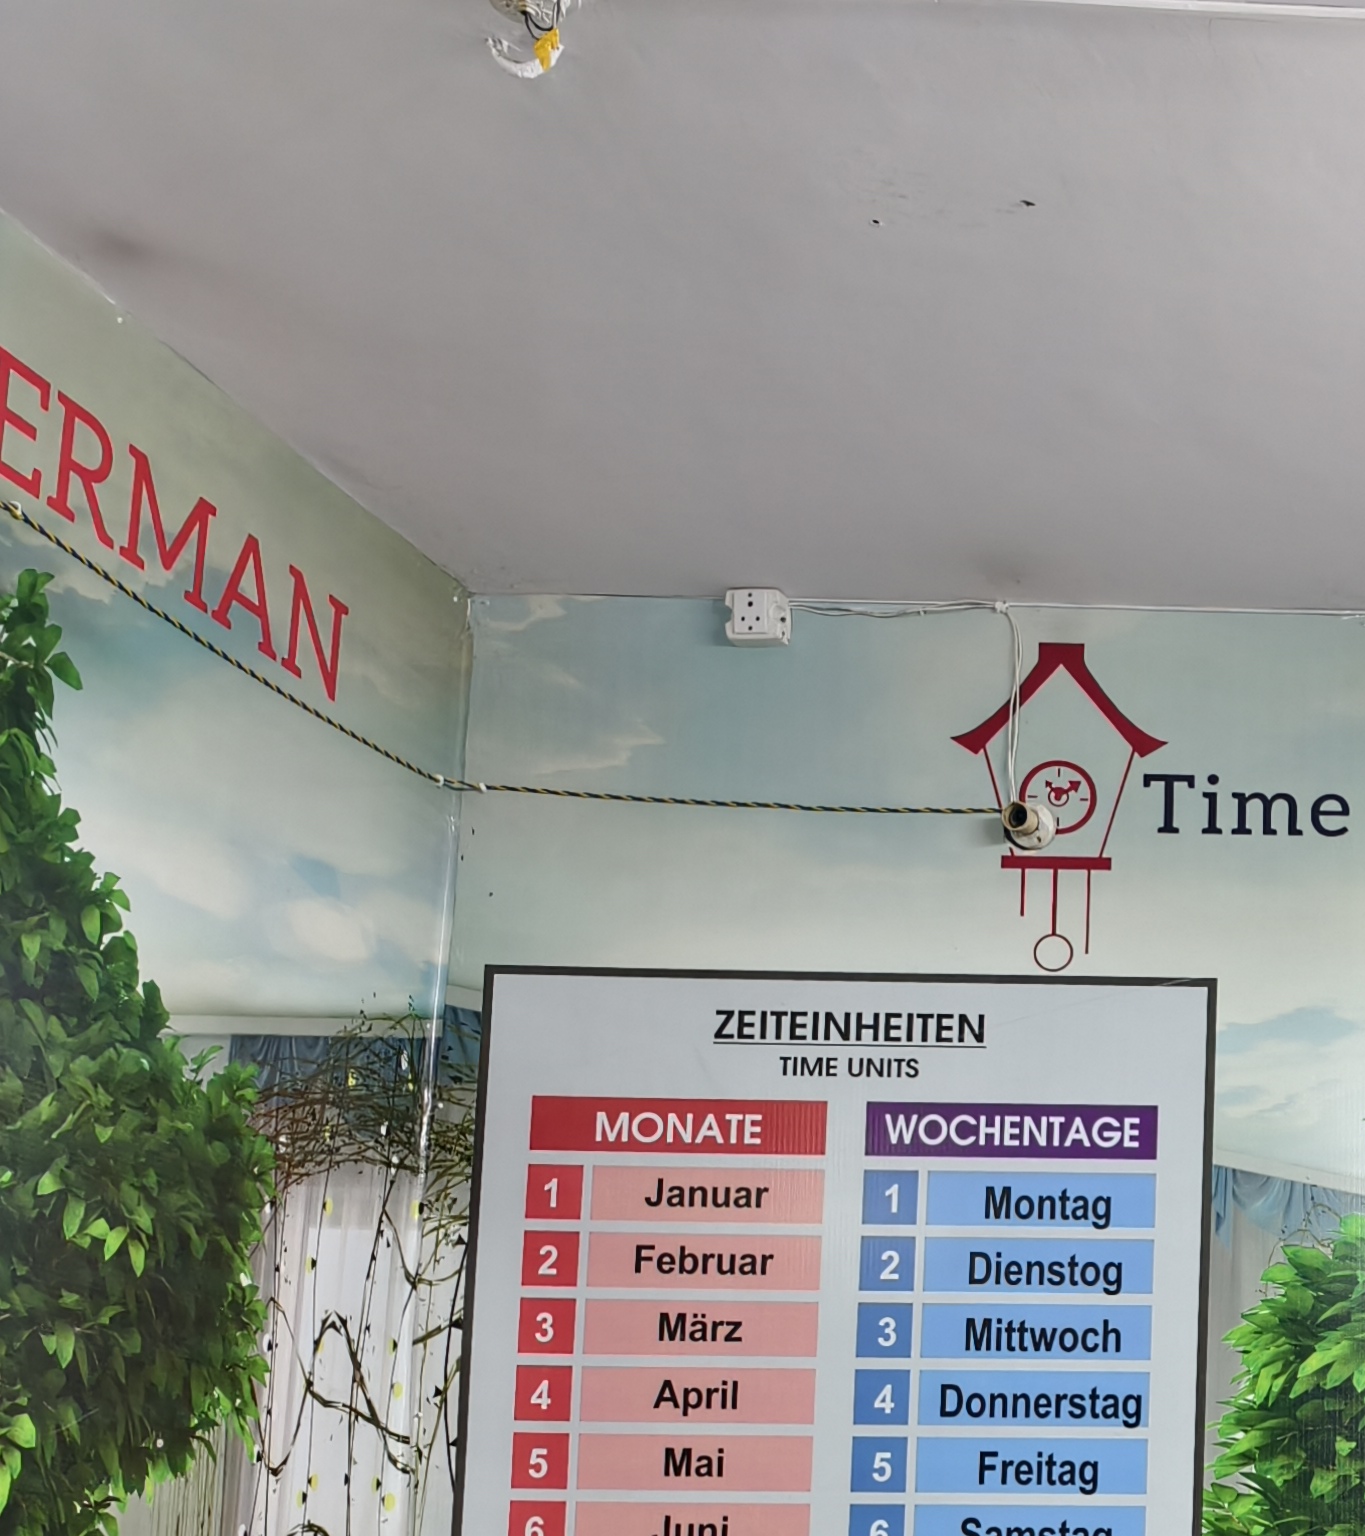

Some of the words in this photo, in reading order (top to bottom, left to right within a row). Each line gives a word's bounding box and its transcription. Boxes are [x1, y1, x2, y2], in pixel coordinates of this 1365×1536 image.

[1142, 773, 1353, 842] Time
[713, 1009, 985, 1045] ZEITEINHEITEN
[779, 1056, 838, 1077] TIME
[847, 1057, 919, 1079] UNITS
[594, 1111, 763, 1146] MONATE
[884, 1113, 1141, 1148] WOCHENTAGE
[543, 1177, 558, 1208] 1
[644, 1177, 770, 1209] Januar
[884, 1183, 899, 1213] 1
[984, 1186, 1112, 1230] Montag
[537, 1244, 558, 1275] 2
[634, 1244, 775, 1276] Februar
[879, 1250, 900, 1280] 2
[534, 1312, 554, 1343] 3
[658, 1312, 743, 1343] März
[877, 1316, 897, 1347] 3
[964, 1317, 1121, 1353] Mittwoch
[530, 1379, 552, 1410] 4
[652, 1379, 739, 1416] April
[873, 1384, 895, 1414] 4
[939, 1383, 1142, 1428] Donnerstag
[528, 1448, 548, 1479] 5
[663, 1447, 725, 1478] Mai
[872, 1451, 892, 1482] 5
[978, 1450, 1099, 1494] Freitag
